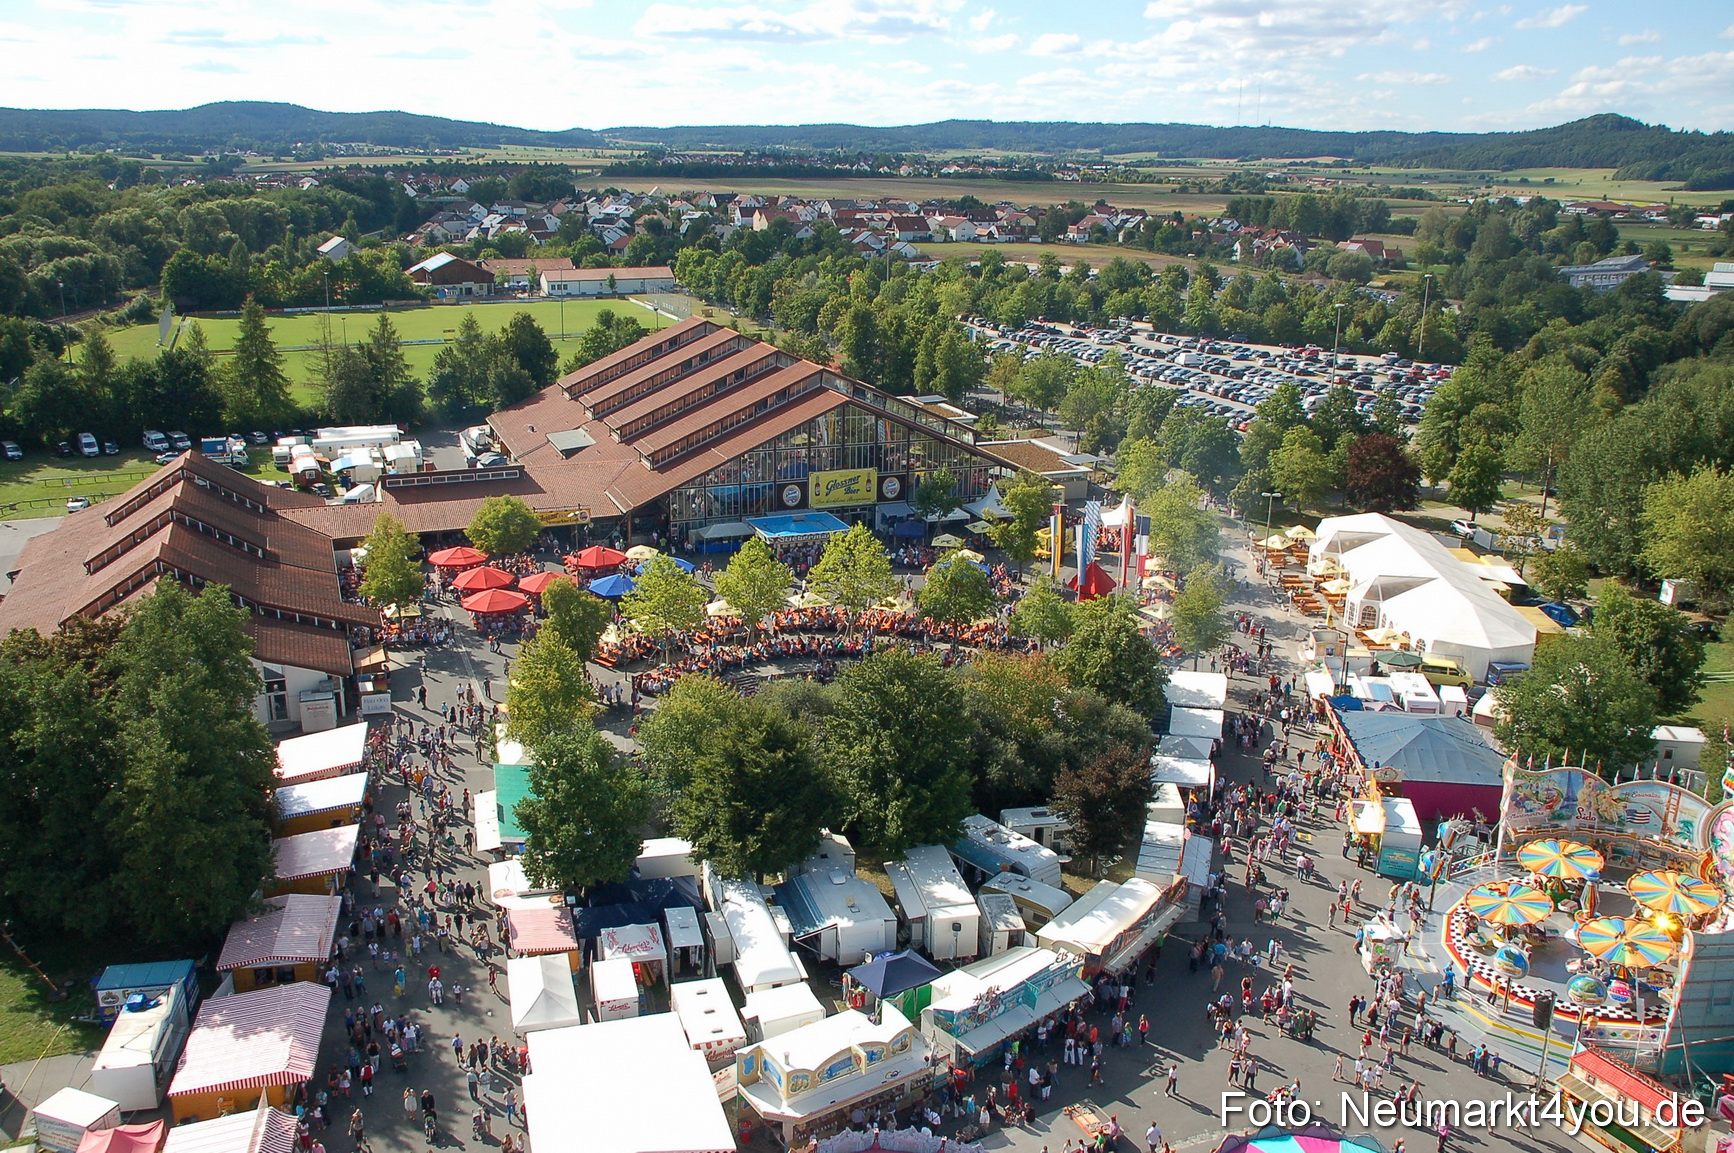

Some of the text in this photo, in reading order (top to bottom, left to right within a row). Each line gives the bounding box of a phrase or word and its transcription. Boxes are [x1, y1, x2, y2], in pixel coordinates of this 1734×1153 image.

[825, 475, 861, 497] Glossner
[844, 486, 860, 495] Bier
[1576, 806, 1596, 821] Lido
